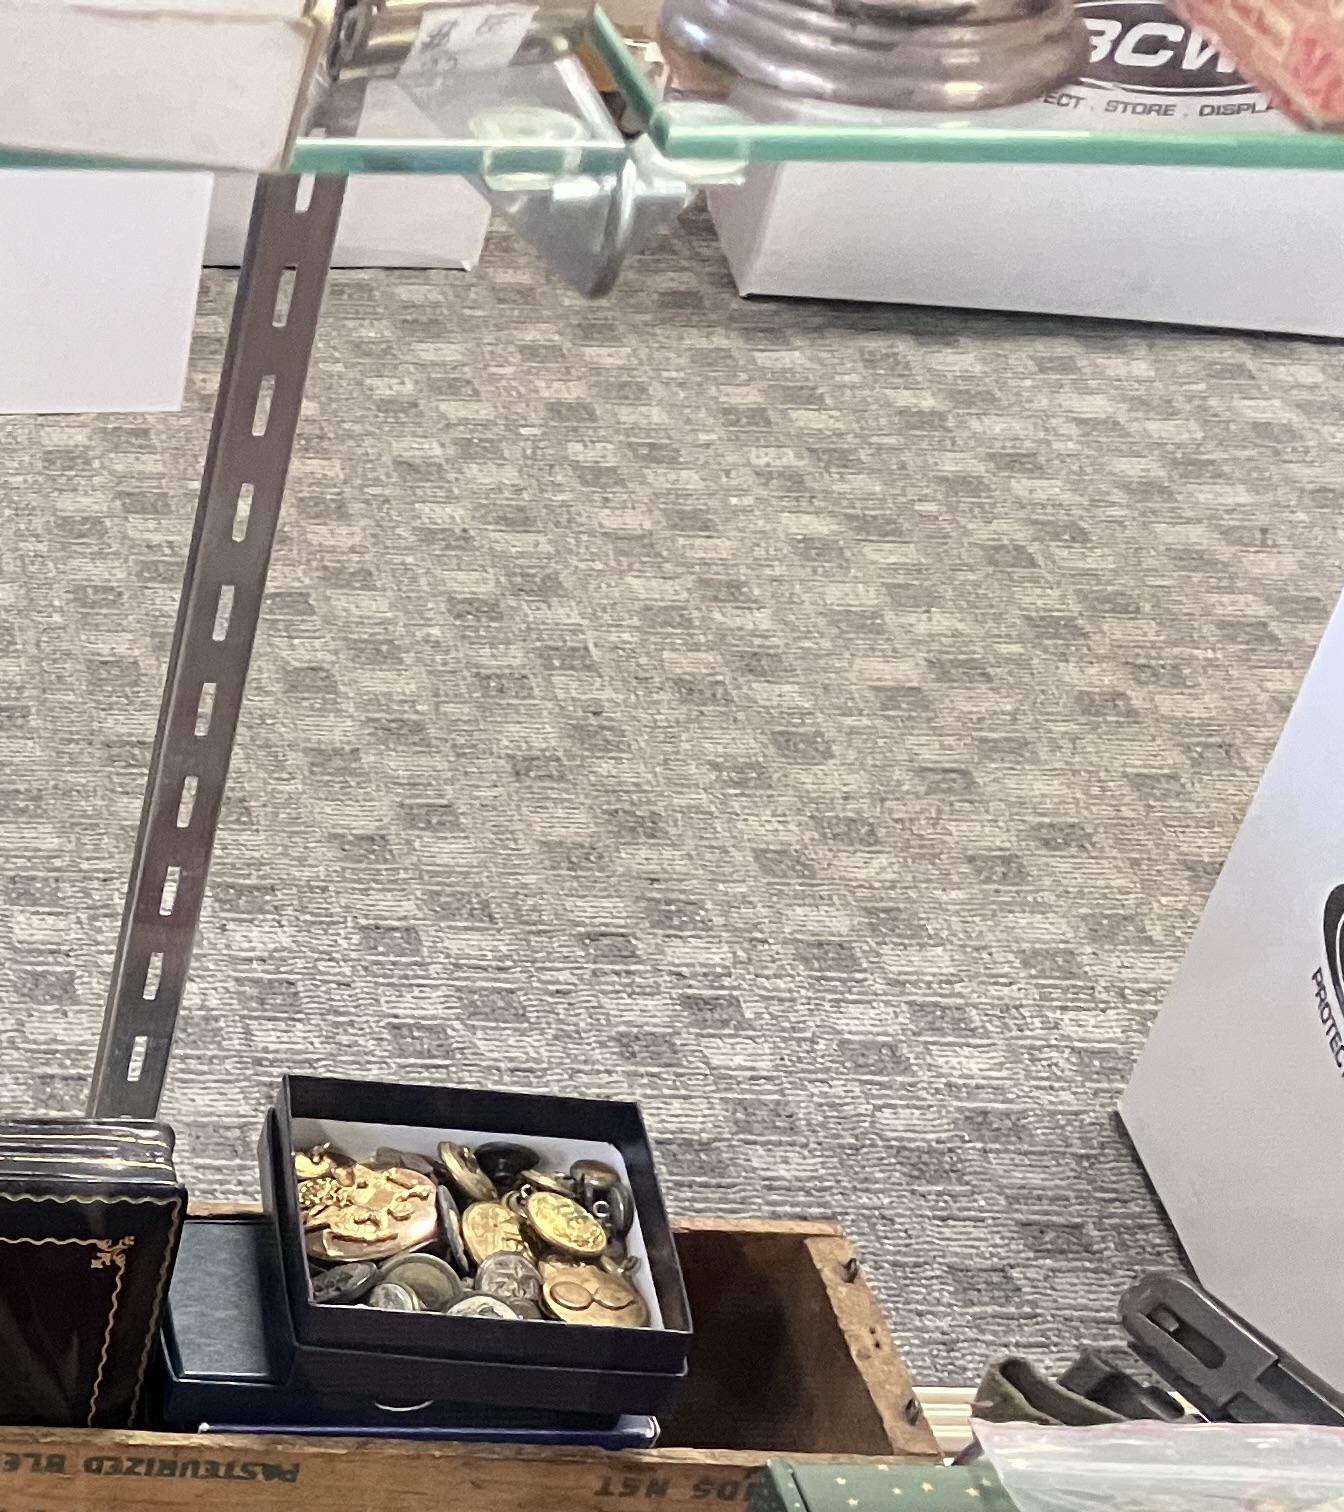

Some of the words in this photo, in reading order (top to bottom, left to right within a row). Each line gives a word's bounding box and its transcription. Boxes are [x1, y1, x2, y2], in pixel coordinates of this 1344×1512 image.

[1104, 100, 1176, 117] STORE
[1199, 103, 1273, 117] DISPL
[83, 1456, 300, 1483] PASTEURIZED
